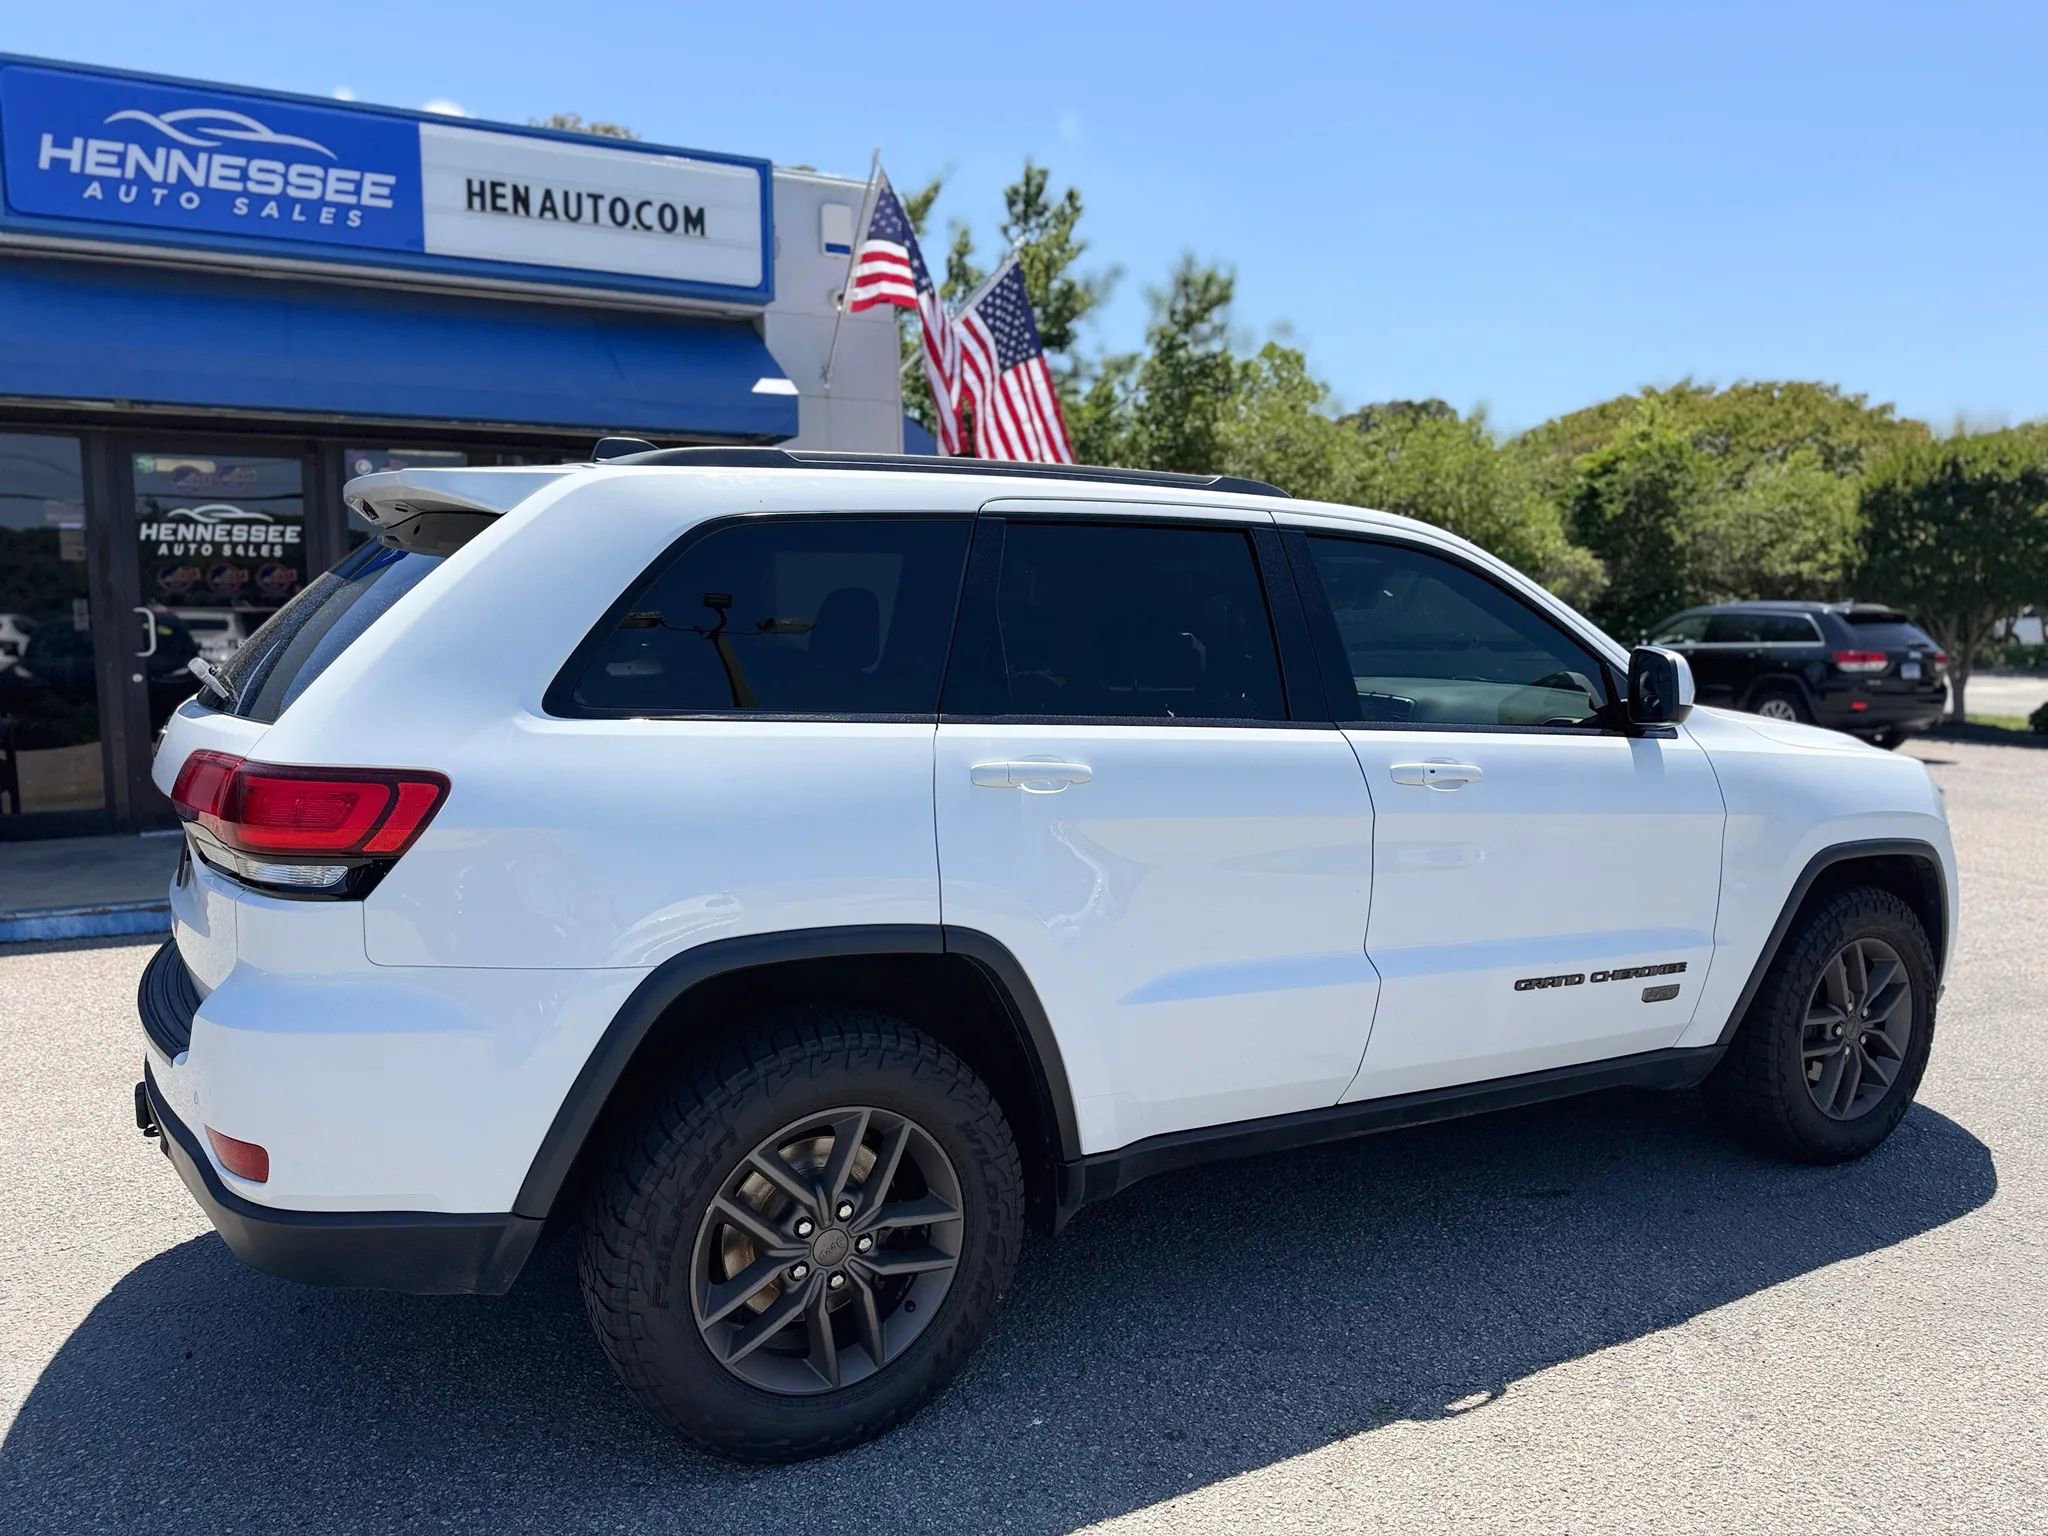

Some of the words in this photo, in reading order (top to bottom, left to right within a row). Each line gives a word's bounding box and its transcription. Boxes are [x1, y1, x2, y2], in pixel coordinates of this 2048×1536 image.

[39, 133, 396, 208] HENNESSEE
[83, 180, 200, 209] AUTO
[233, 197, 362, 227] SALES
[139, 522, 301, 543] HENNESSEE
[157, 543, 213, 557] AUTO
[222, 544, 283, 557] SALES
[1514, 973, 1585, 991] GRAND
[1590, 961, 1687, 983] CHEROKEE
